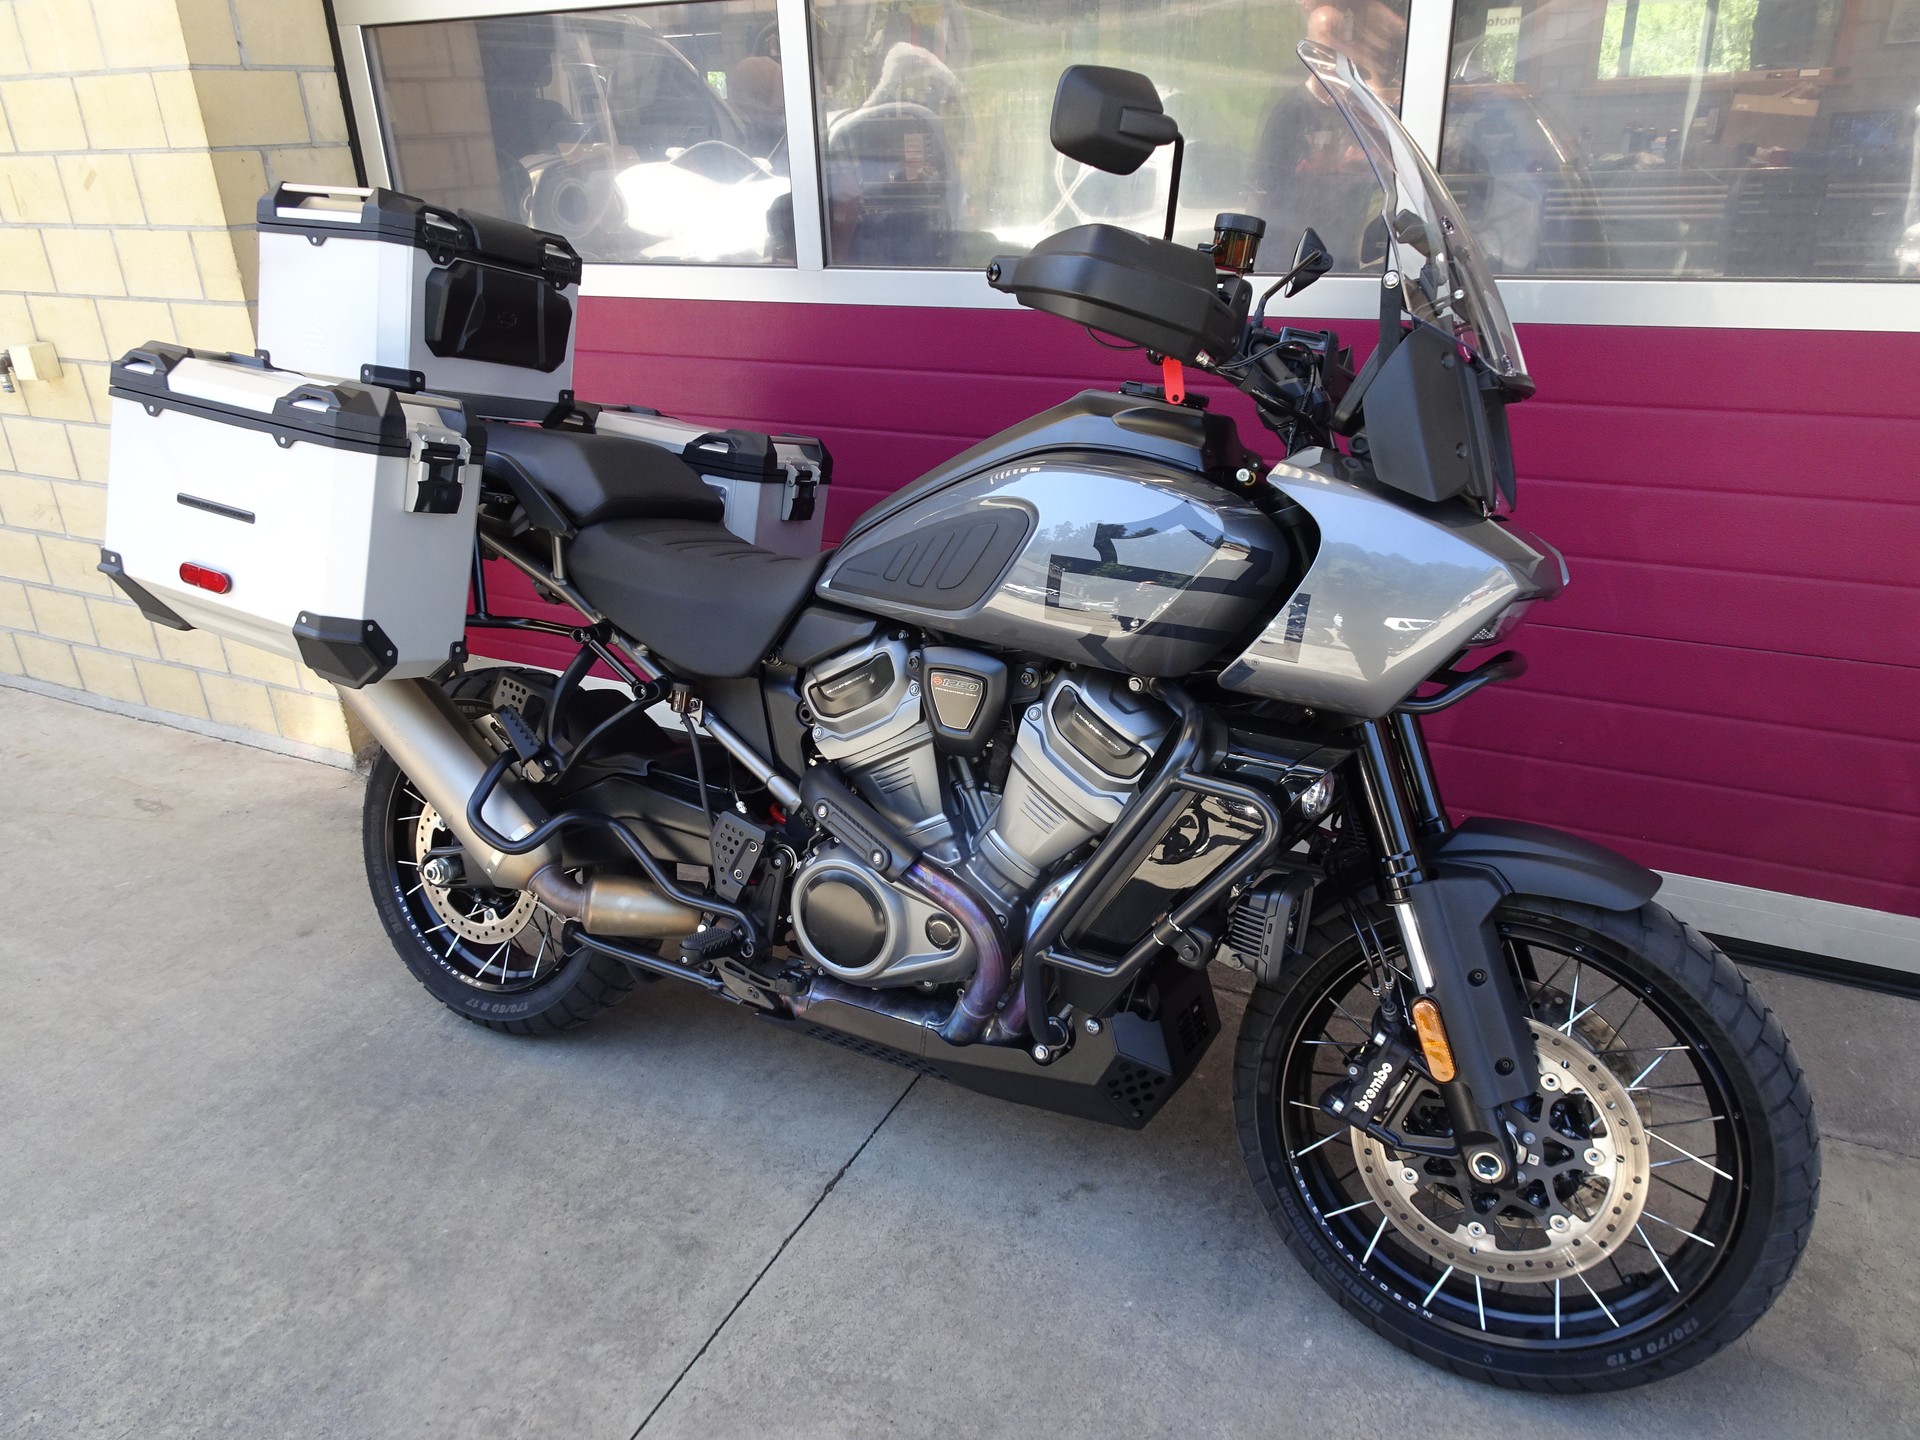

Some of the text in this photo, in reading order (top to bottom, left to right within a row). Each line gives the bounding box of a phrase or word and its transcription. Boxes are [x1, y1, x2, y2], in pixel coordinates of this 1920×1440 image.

[943, 678, 979, 692] 1250
[465, 998, 528, 1013] 170/60 R 17
[1354, 1062, 1393, 1112] brembo
[1290, 1150, 1433, 1319] HARLEY-DAVIDSON
[1606, 1317, 1699, 1368] 120/70 R 19
